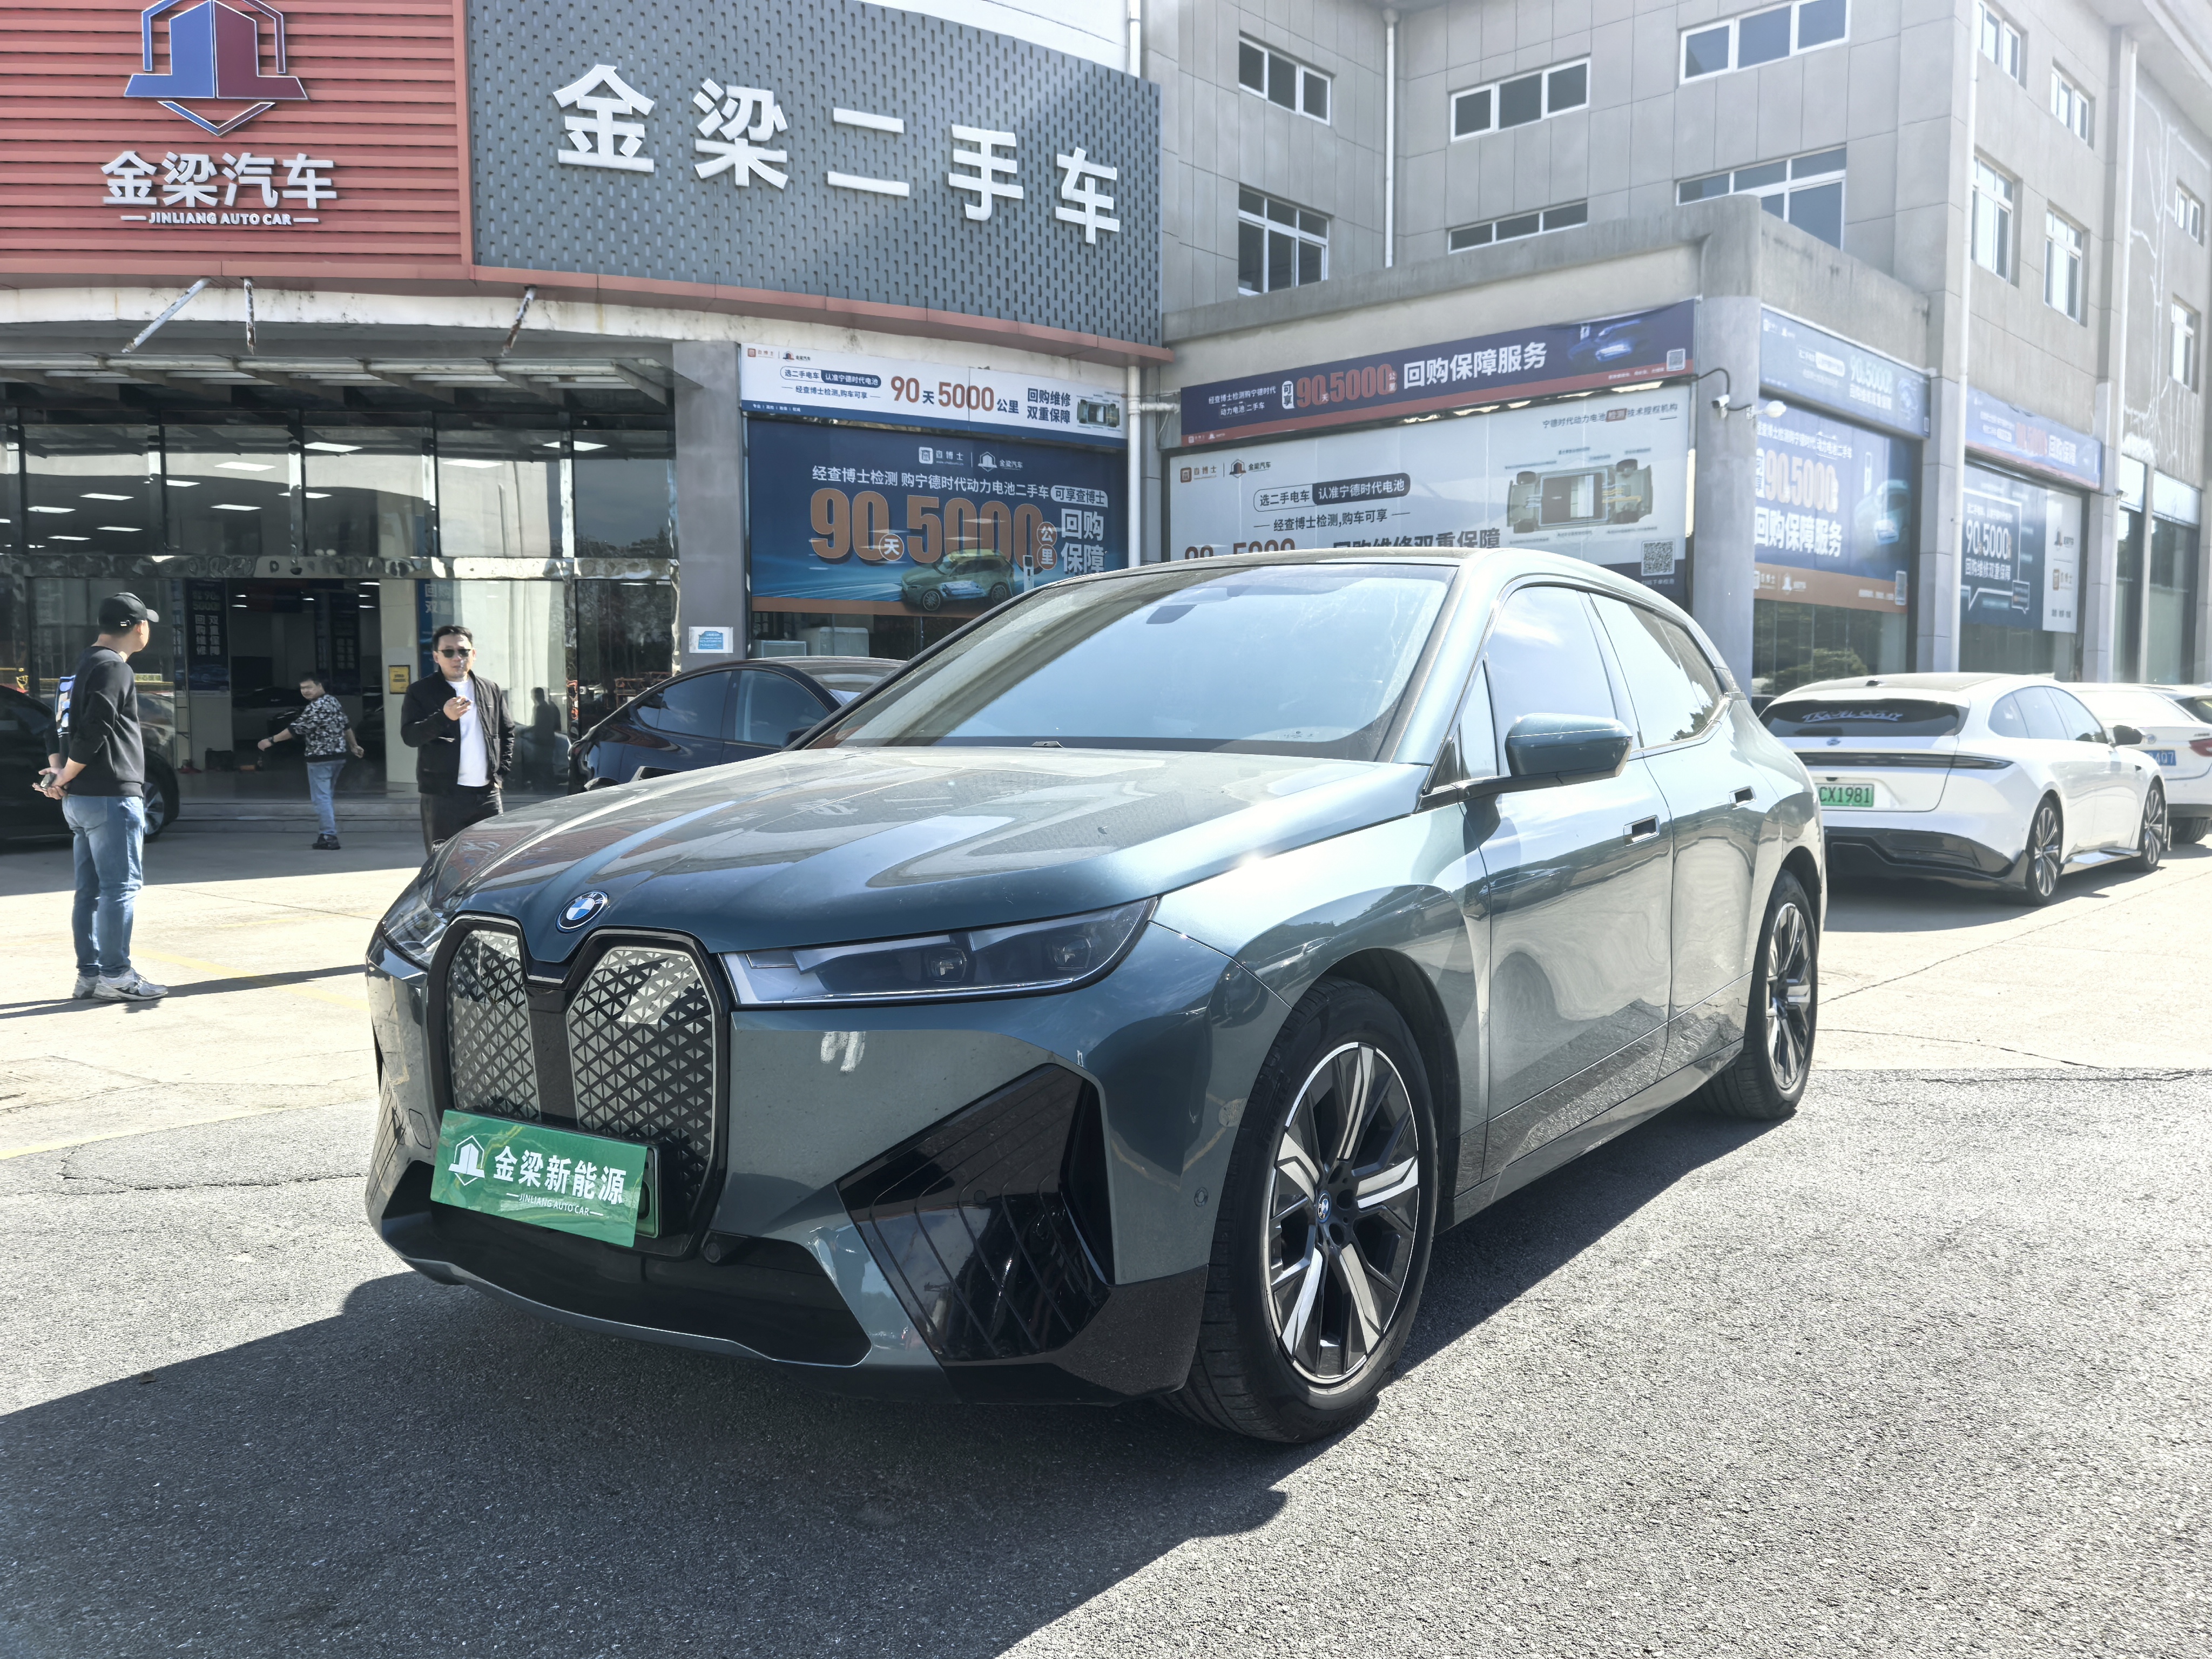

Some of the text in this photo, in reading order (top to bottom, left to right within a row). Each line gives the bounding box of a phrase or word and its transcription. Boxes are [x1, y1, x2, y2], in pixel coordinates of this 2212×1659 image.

[552, 64, 1120, 245] 金梁二手车
[101, 150, 338, 210] 金梁汽车
[148, 212, 292, 226] JINLIANG AUTO CAR
[785, 369, 819, 379] 选二手电车
[1404, 342, 1547, 389] 回购保障服务
[891, 375, 1019, 414] 90天5000公里
[1027, 387, 1071, 407] 回购维修
[1027, 406, 1070, 424] 双重保障
[812, 466, 1105, 505] 经查博士检测 购宁德时代动力电池二手车 可享查博士
[1259, 478, 1405, 507] 选二手电车 认准宁德时代电池
[811, 488, 889, 562] 90
[907, 495, 1043, 574] 5000
[1061, 508, 1103, 541] 回购
[1273, 509, 1388, 532] 经查博士检测,购车可享
[1061, 543, 1104, 574] 保障
[1819, 786, 1870, 803] CX1981
[493, 1145, 627, 1205] 金梁新能源
[518, 1193, 589, 1216] JINLIANG AUTO CAR
